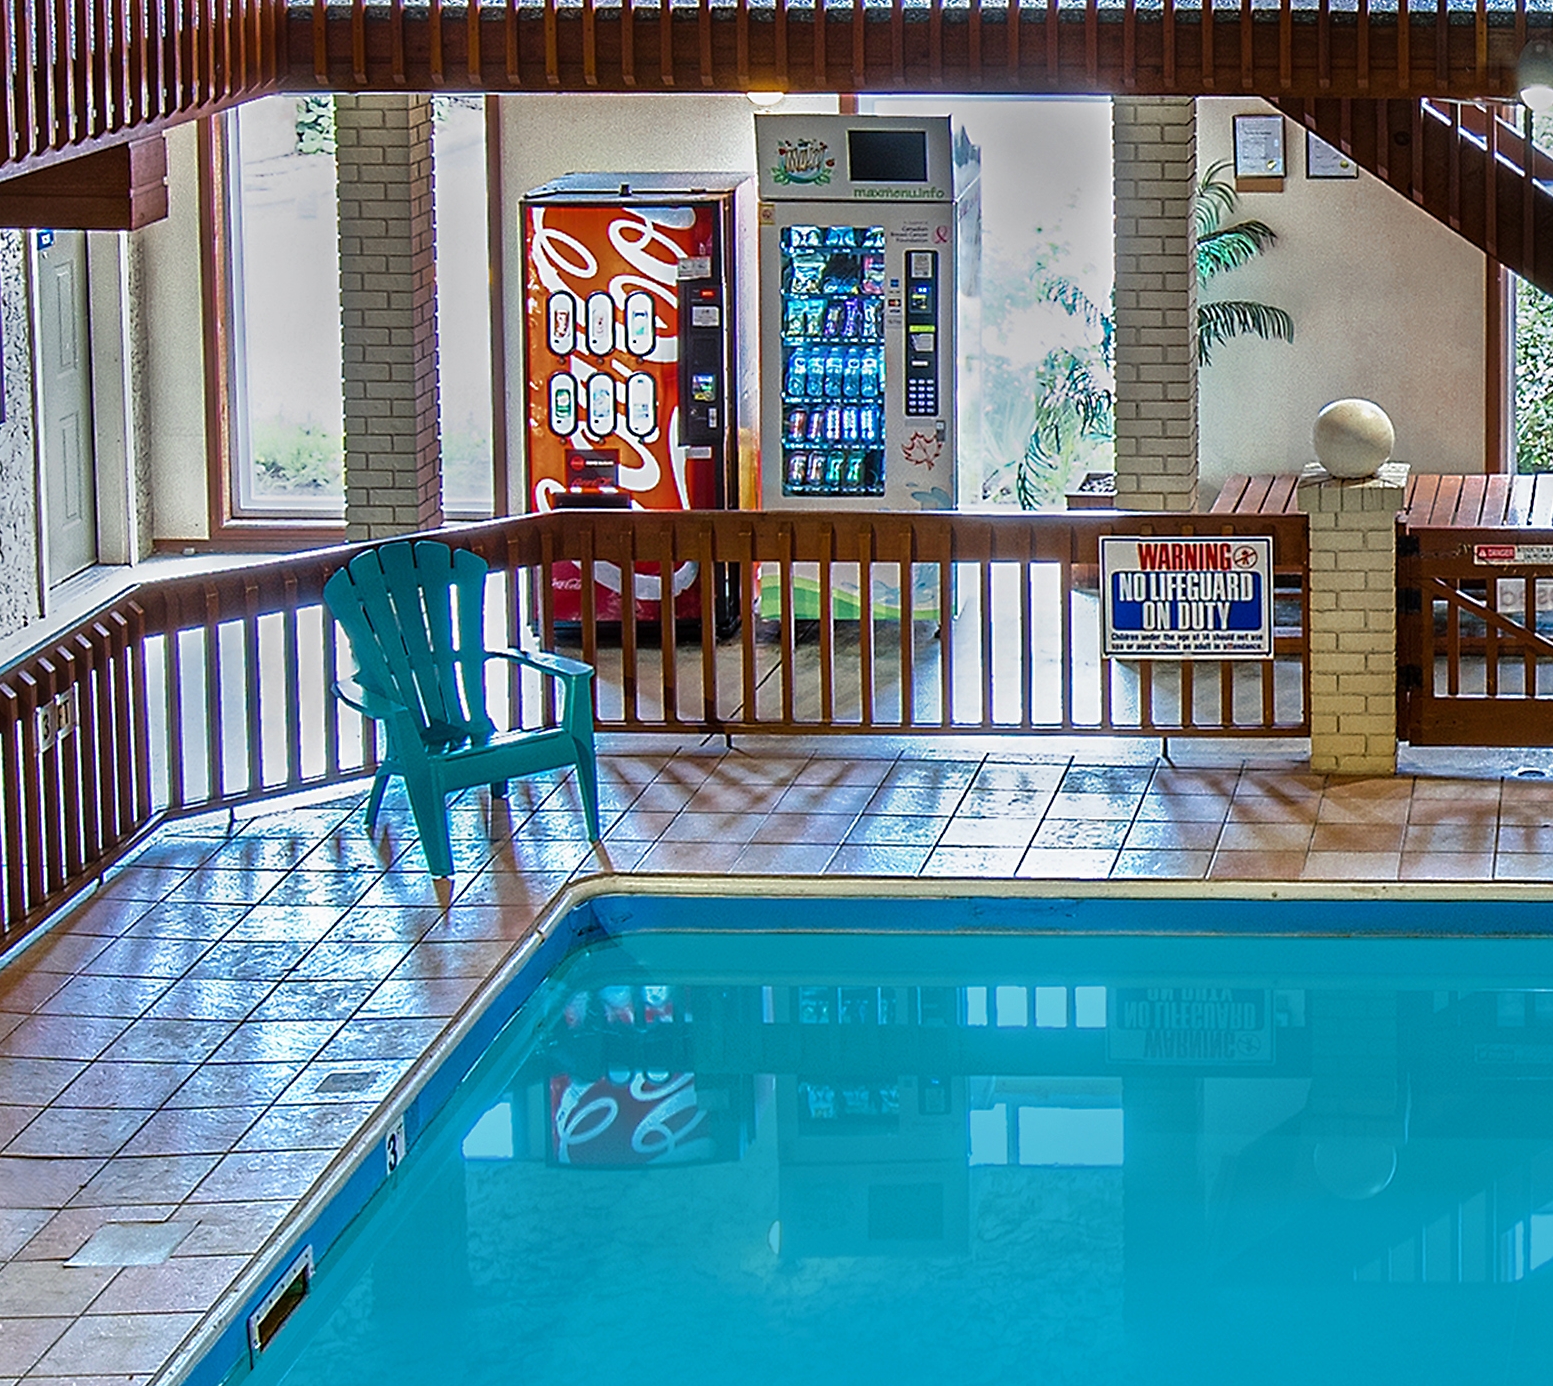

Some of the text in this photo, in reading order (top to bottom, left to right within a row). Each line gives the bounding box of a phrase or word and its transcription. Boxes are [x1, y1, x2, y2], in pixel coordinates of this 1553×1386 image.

[854, 186, 946, 198] maxmenu.info
[1137, 543, 1232, 571] WARNING
[1119, 573, 1253, 601] NO LIFEGUARD
[1143, 602, 1230, 630] ON DUTY
[1111, 632, 1138, 641] Children
[1142, 633, 1160, 641] under
[1164, 633, 1174, 641] the
[1178, 634, 1189, 642] age
[1193, 633, 1199, 641] of
[1212, 633, 1234, 641] should
[1237, 633, 1248, 641] not
[1154, 642, 1179, 650] without
[1194, 642, 1211, 650] adult
[387, 1133, 397, 1171] 3
